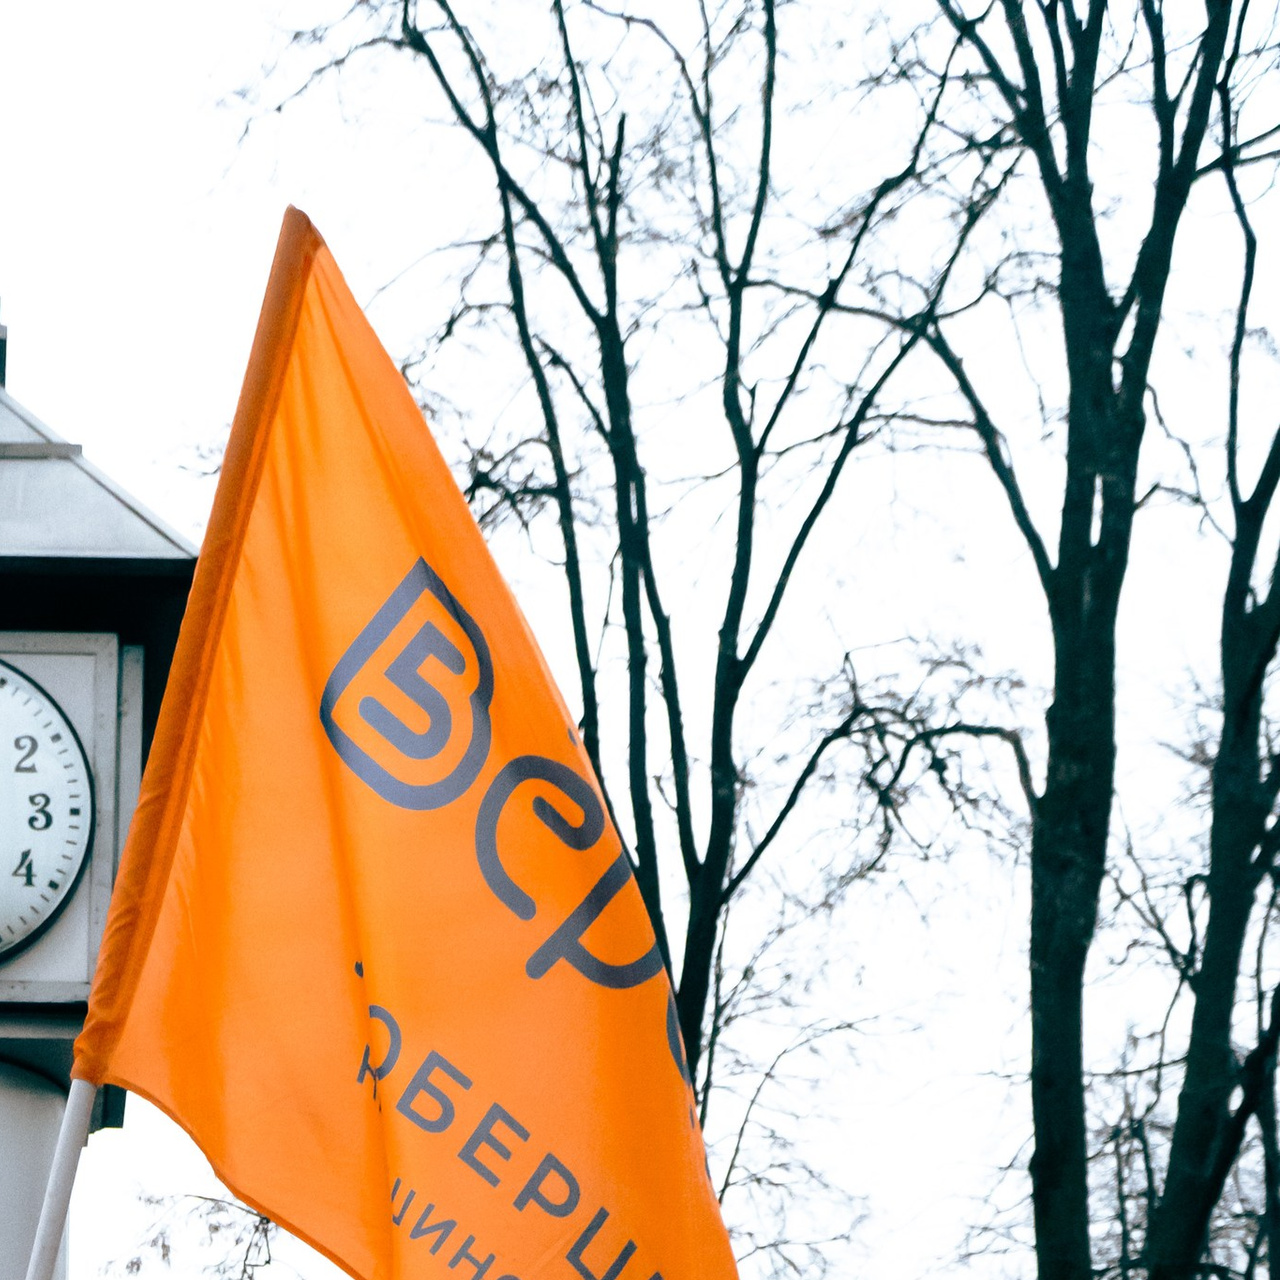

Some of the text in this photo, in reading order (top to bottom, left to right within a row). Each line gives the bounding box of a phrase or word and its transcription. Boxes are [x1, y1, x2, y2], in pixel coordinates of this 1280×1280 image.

[14, 735, 39, 773] 2
[28, 793, 53, 831] 3
[12, 849, 37, 887] 4
